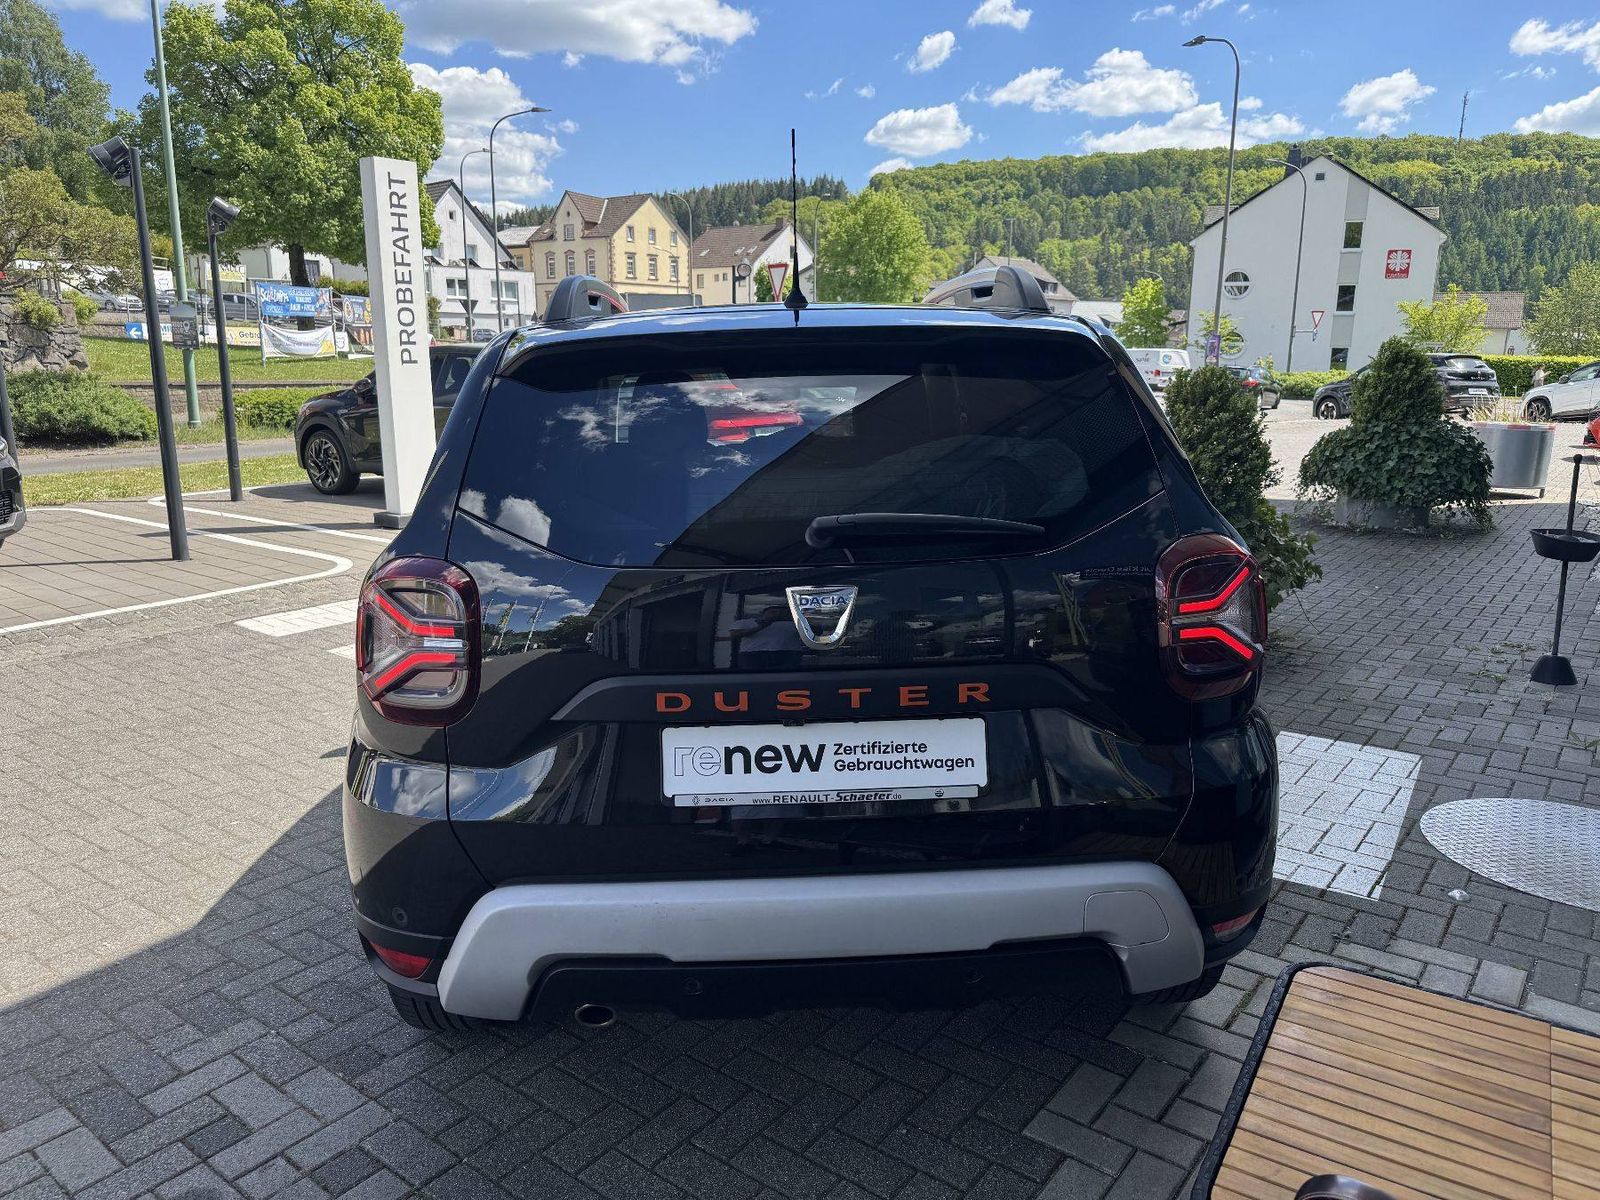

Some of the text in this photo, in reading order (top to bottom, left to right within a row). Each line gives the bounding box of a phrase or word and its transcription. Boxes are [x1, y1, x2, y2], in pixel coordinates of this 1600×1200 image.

[387, 171, 418, 366] PROBEFAHRT
[799, 596, 848, 606] DACIA
[656, 682, 991, 712] DUSTER
[674, 743, 826, 776] renew
[833, 741, 928, 756] Zertifizierte
[834, 757, 975, 772] Gebrauchtwagen
